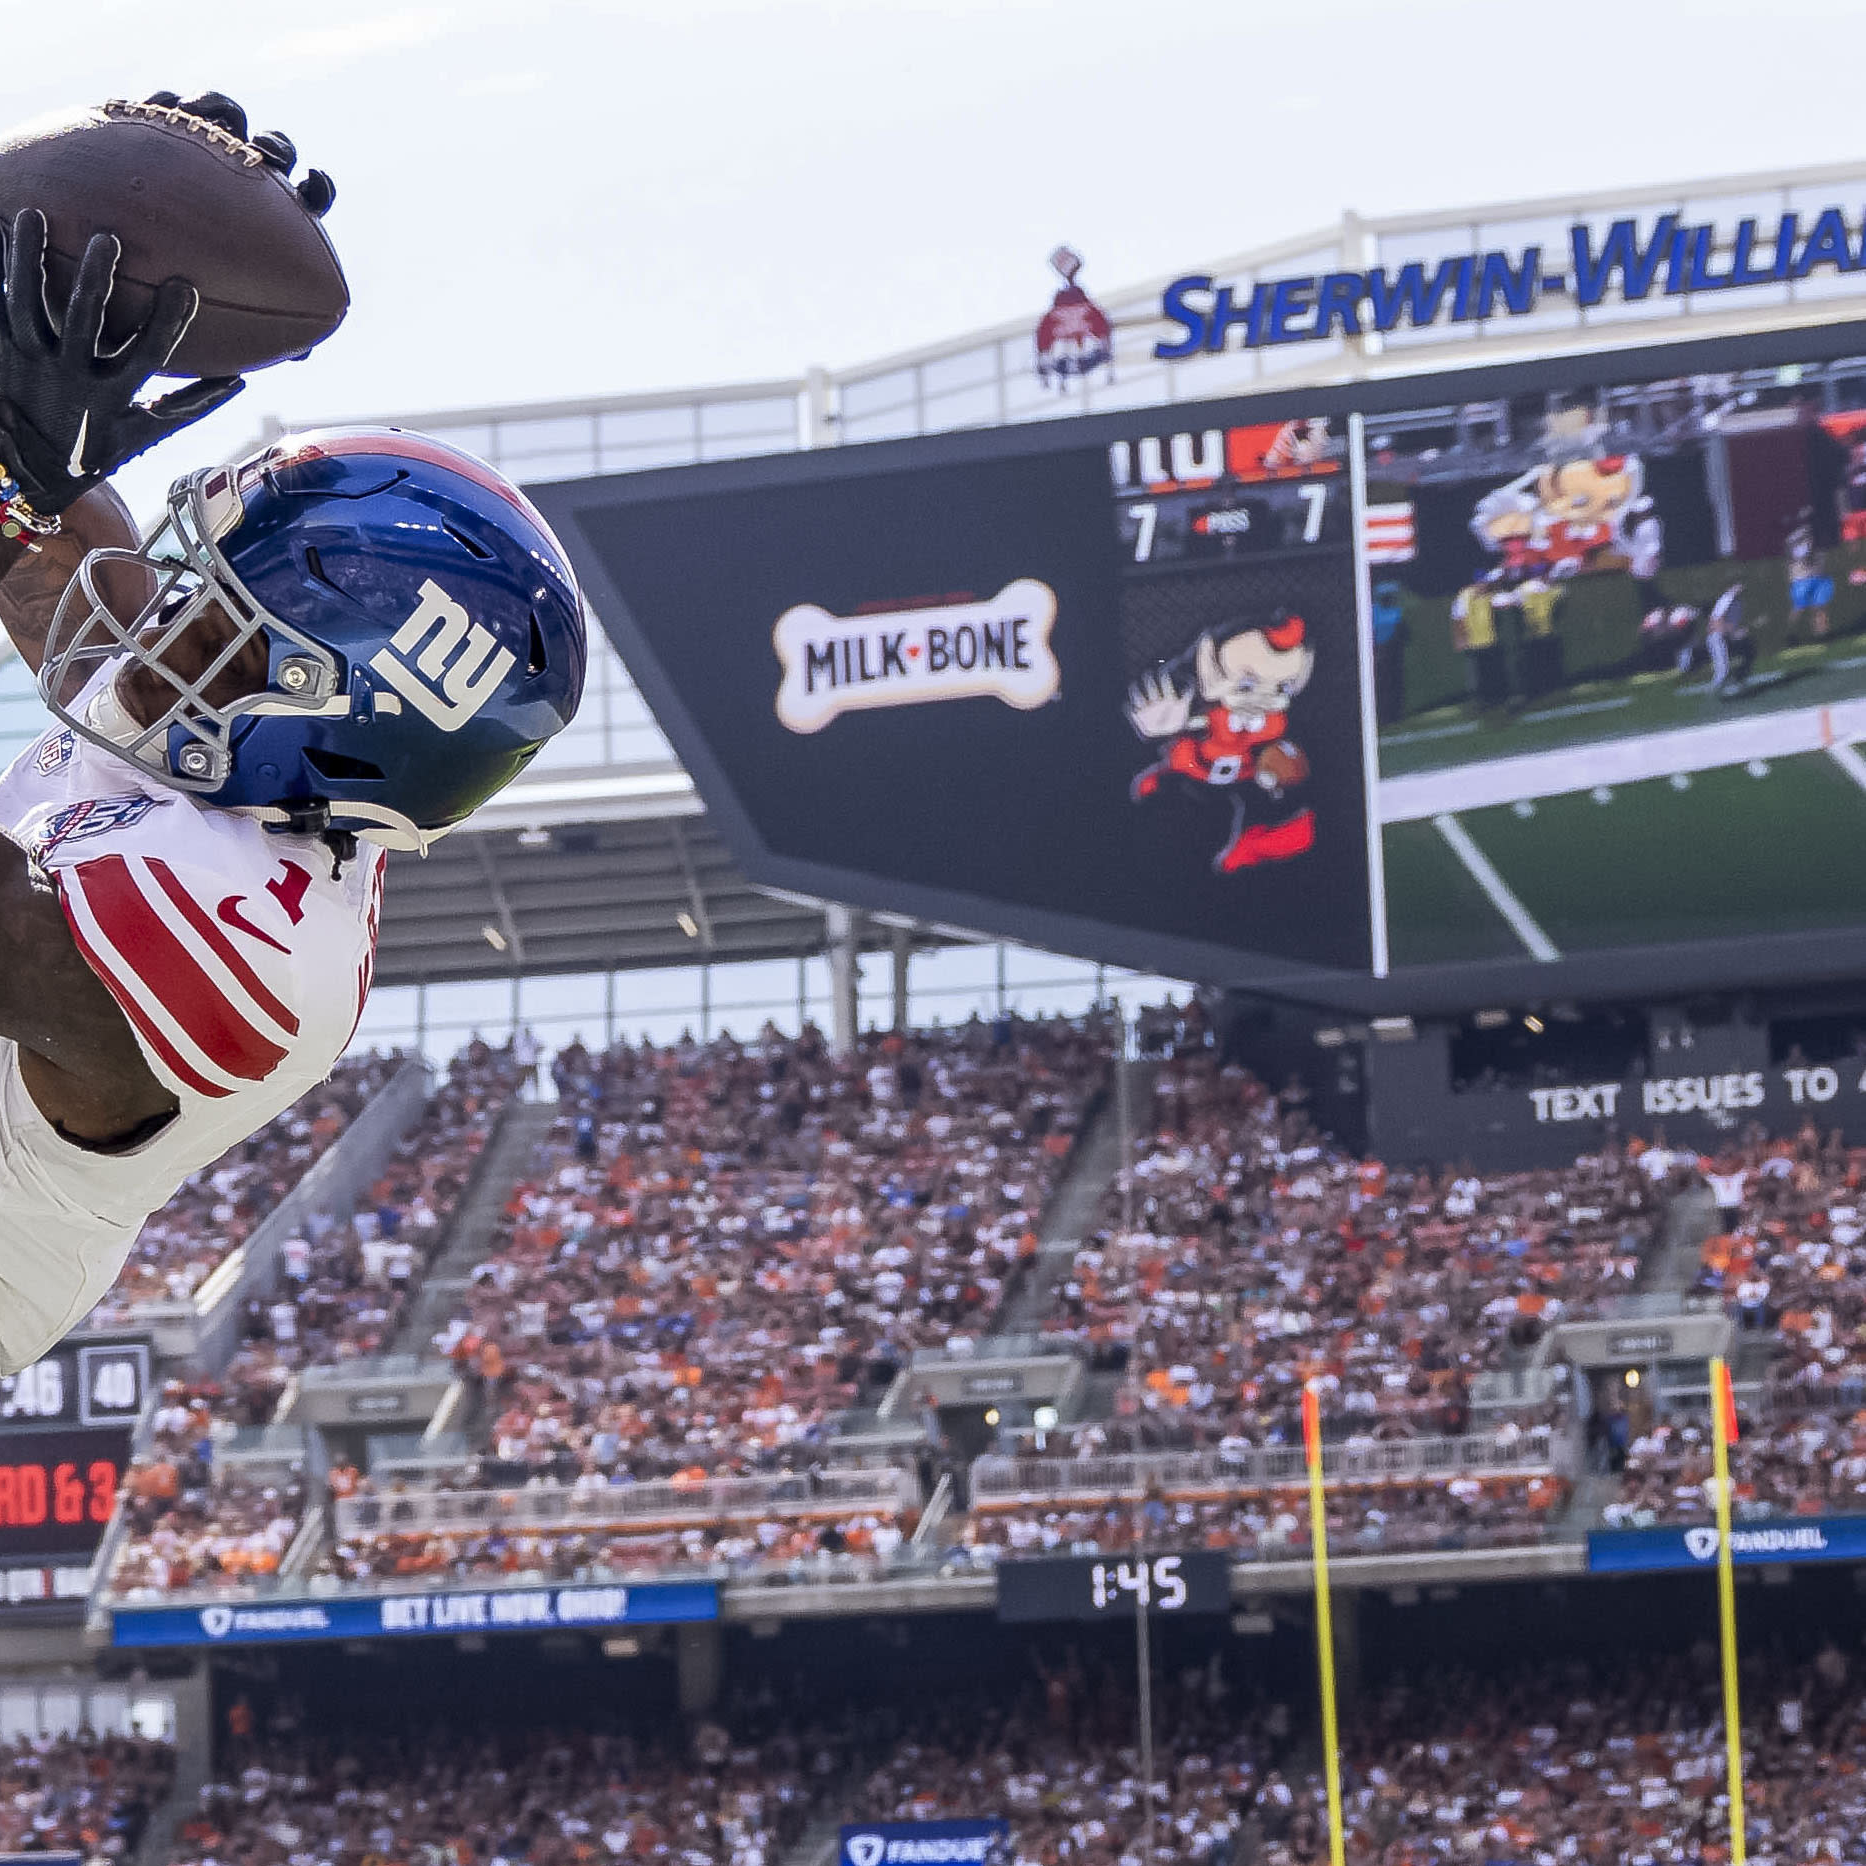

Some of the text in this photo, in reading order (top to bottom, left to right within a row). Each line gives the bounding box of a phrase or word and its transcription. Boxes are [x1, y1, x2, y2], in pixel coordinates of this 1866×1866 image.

[1153, 202, 1866, 361] SHERWIN-WILLIA
[1128, 483, 1328, 562] 7 7
[804, 615, 1031, 695] MILK BONE
[41, 738, 62, 769] NFL
[1528, 1083, 1621, 1122] TEXT
[1642, 1072, 1765, 1115] ISSUES
[1783, 1066, 1839, 1103] TO
[52, 1461, 85, 1524] &
[88, 1458, 117, 1523] 3
[1092, 1556, 1188, 1610] 1:45
[380, 1597, 427, 1632] BET
[431, 1594, 486, 1629] LIVE
[887, 1837, 992, 1865] FANDUE
